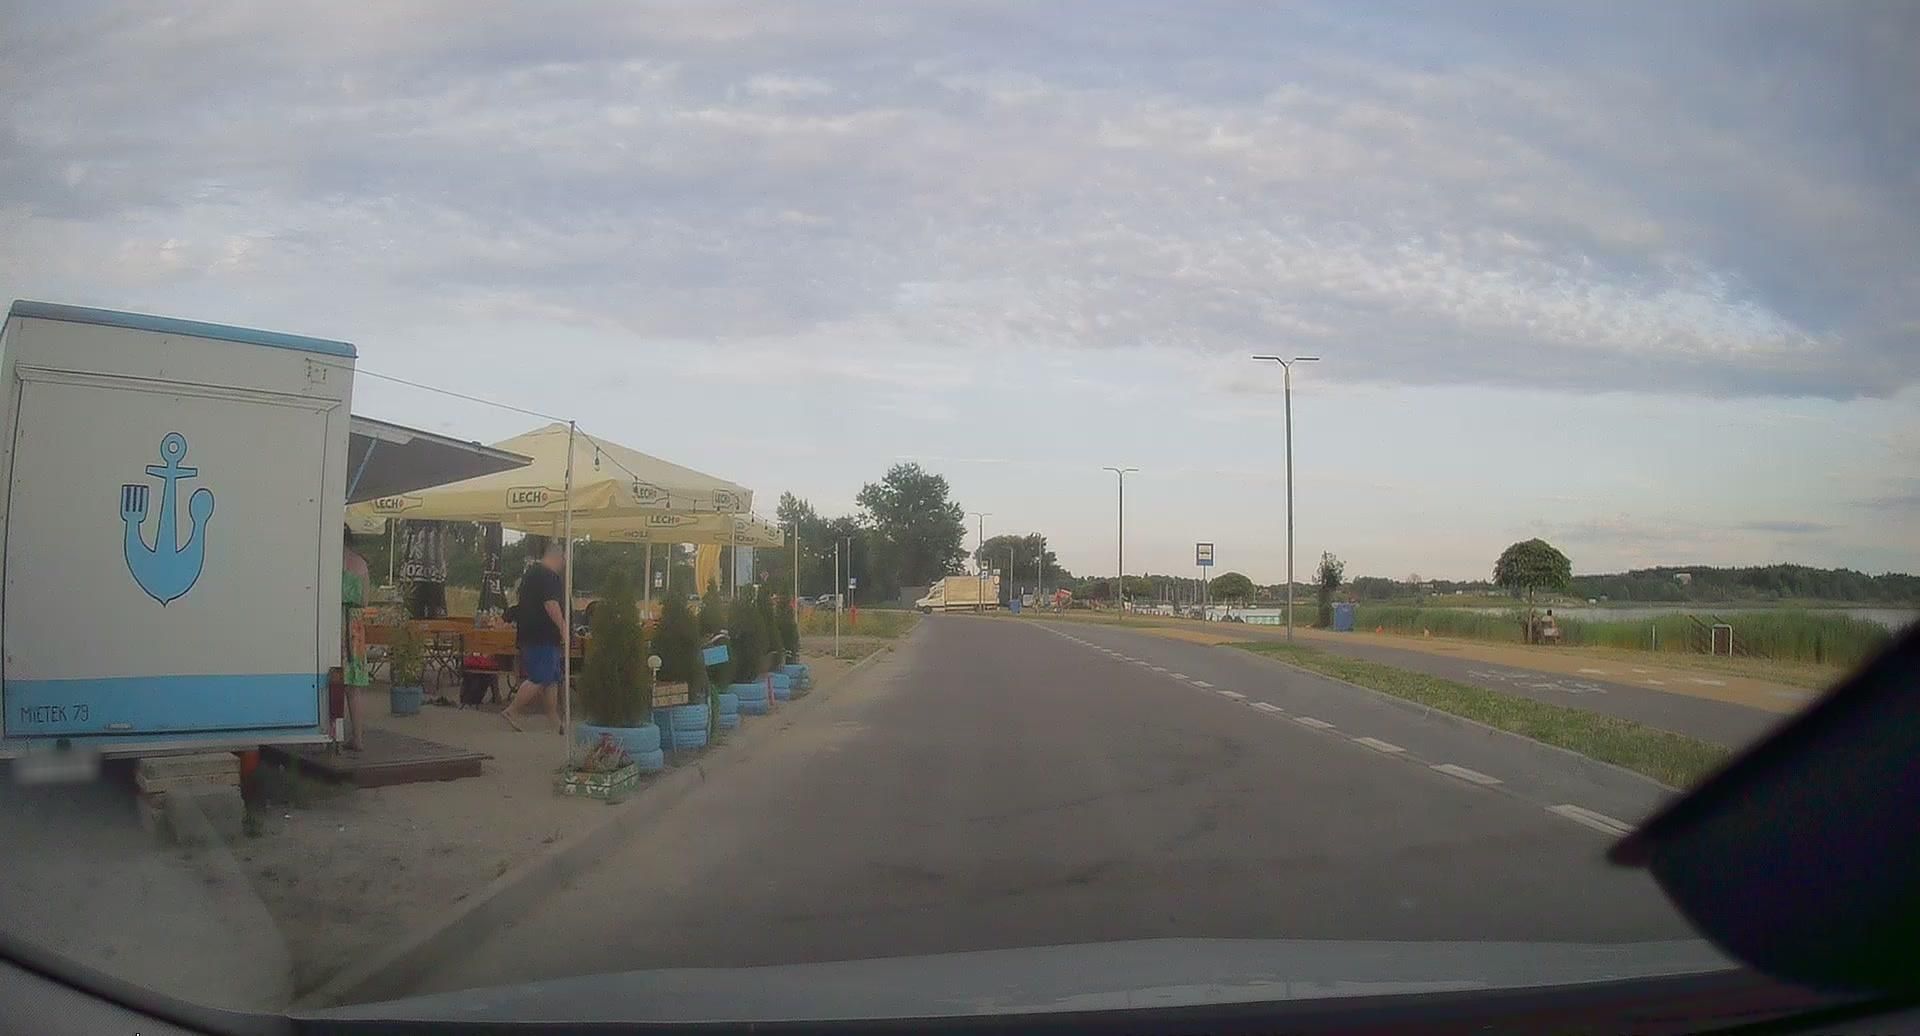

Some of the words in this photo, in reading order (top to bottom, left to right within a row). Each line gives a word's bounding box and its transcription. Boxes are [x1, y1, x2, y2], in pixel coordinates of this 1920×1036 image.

[375, 498, 399, 509] LECH
[512, 491, 541, 504] LECH
[650, 515, 675, 524] LECH
[73, 704, 89, 722] 79
